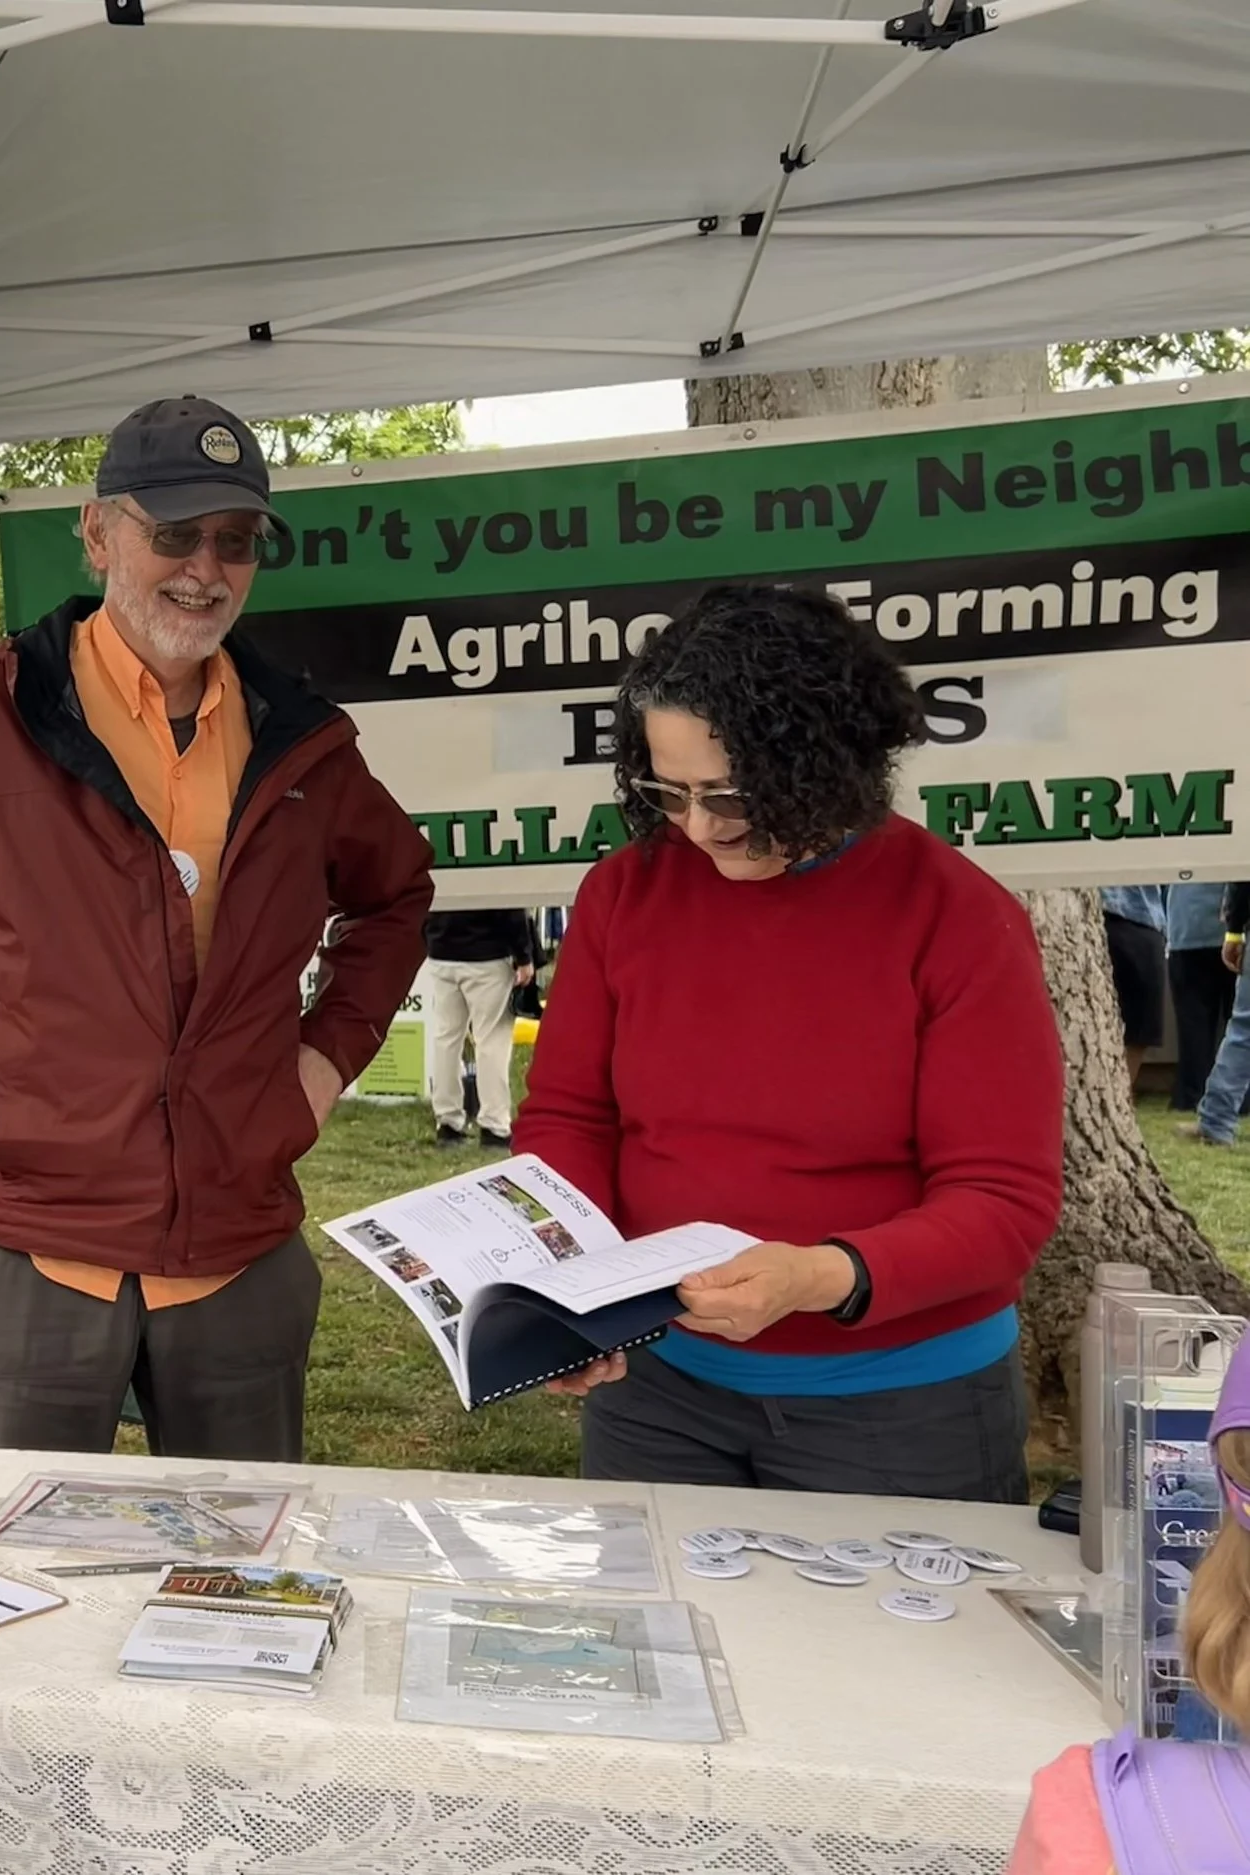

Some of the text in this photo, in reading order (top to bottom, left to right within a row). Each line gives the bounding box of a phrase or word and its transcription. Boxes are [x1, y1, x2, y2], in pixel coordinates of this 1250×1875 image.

[254, 505, 413, 570] on't
[433, 505, 588, 574] you
[617, 482, 723, 544] be
[754, 479, 887, 542] my
[919, 770, 1235, 847] FARM
[526, 1164, 592, 1218] PROCESS
